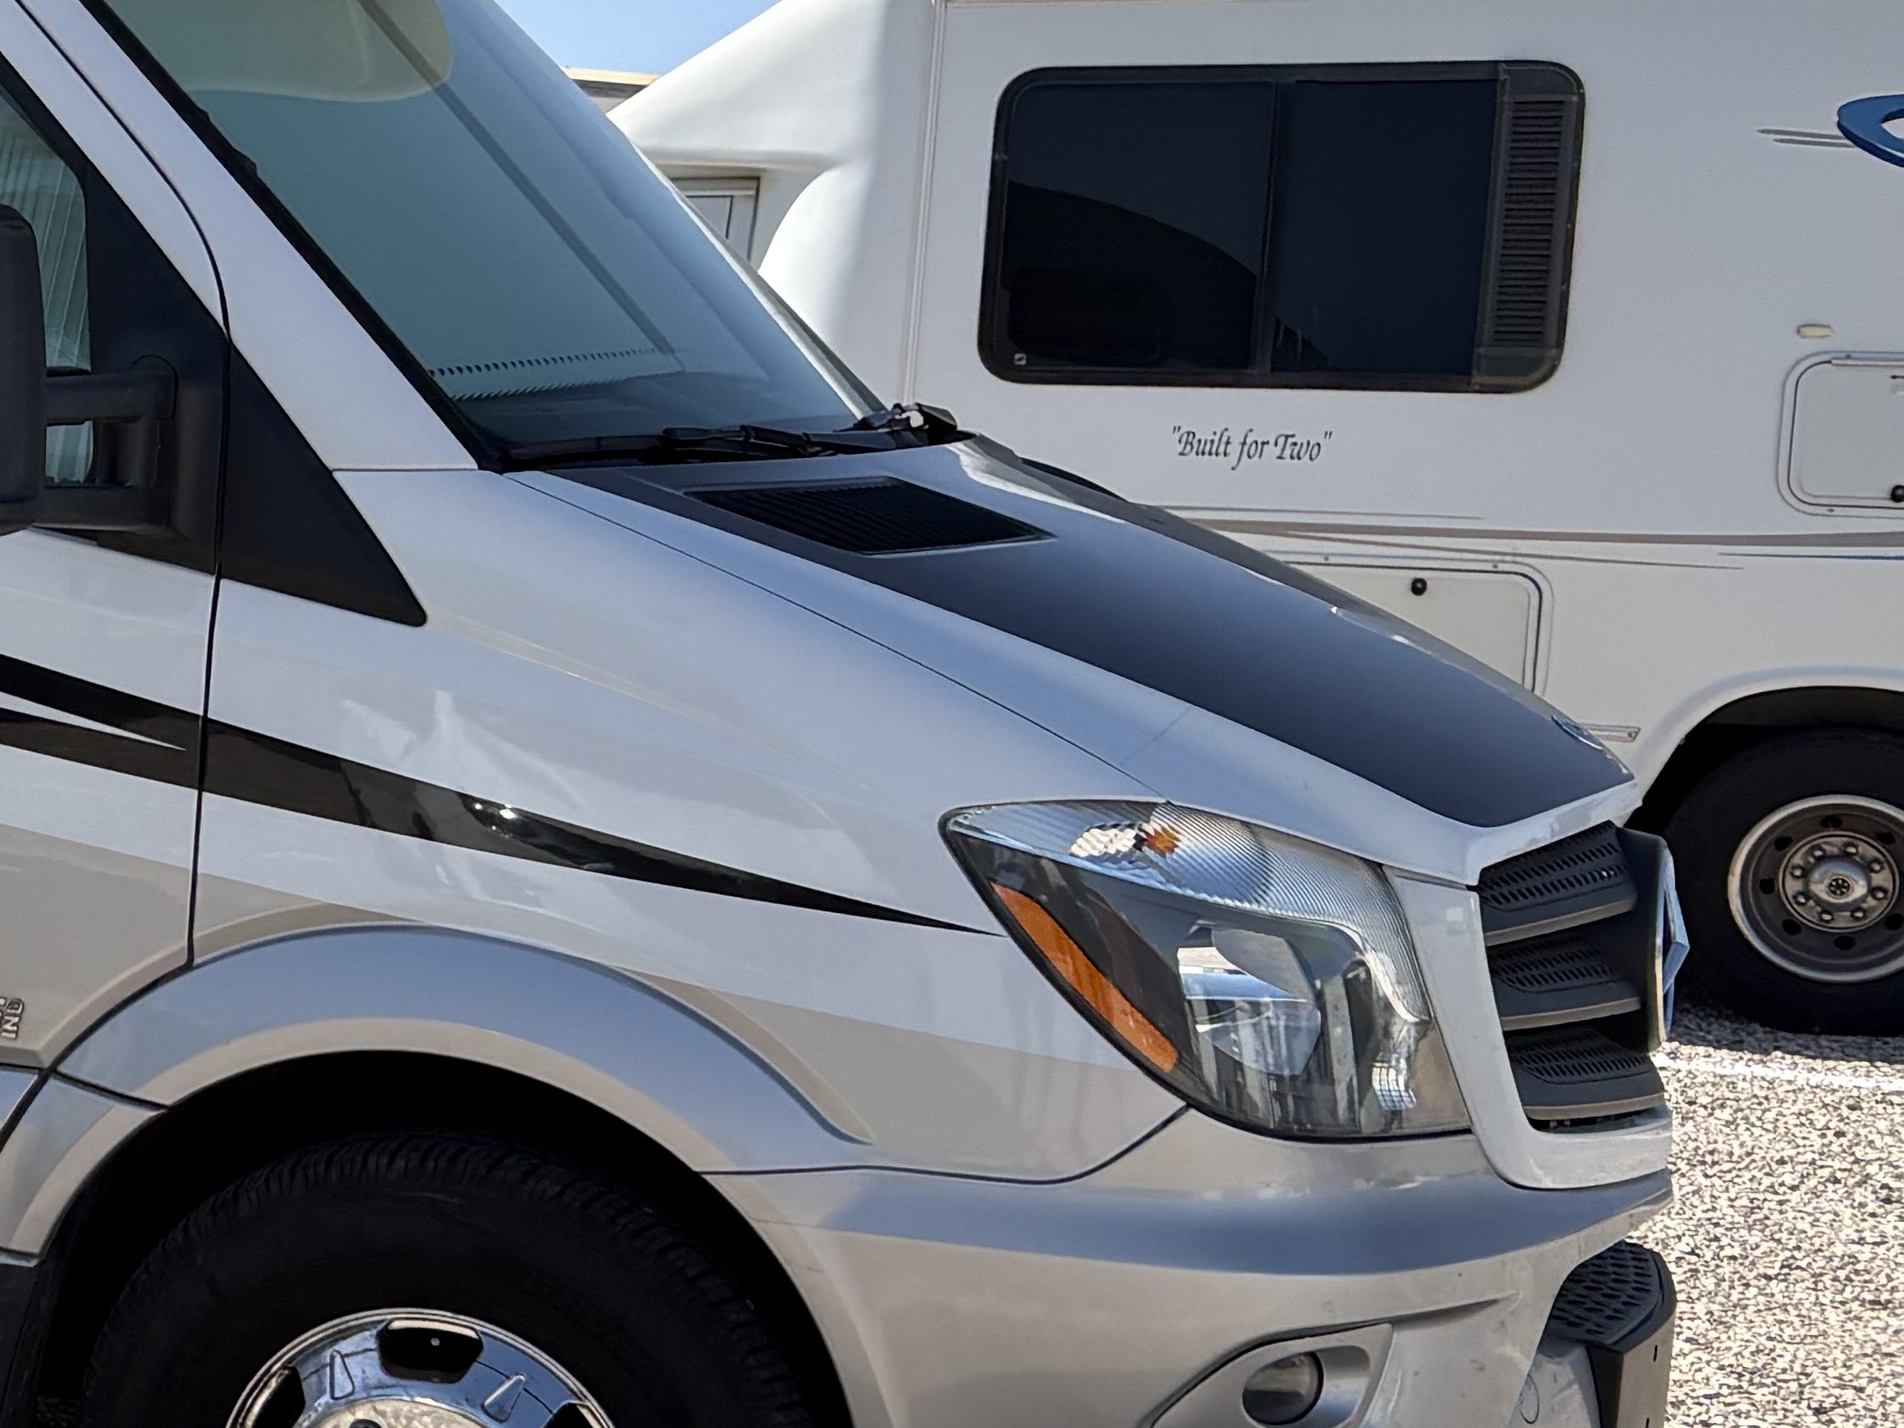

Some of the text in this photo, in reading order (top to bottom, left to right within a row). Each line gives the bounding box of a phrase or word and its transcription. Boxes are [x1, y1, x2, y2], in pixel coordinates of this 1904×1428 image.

[1172, 425, 1333, 471] "Built for Two"
